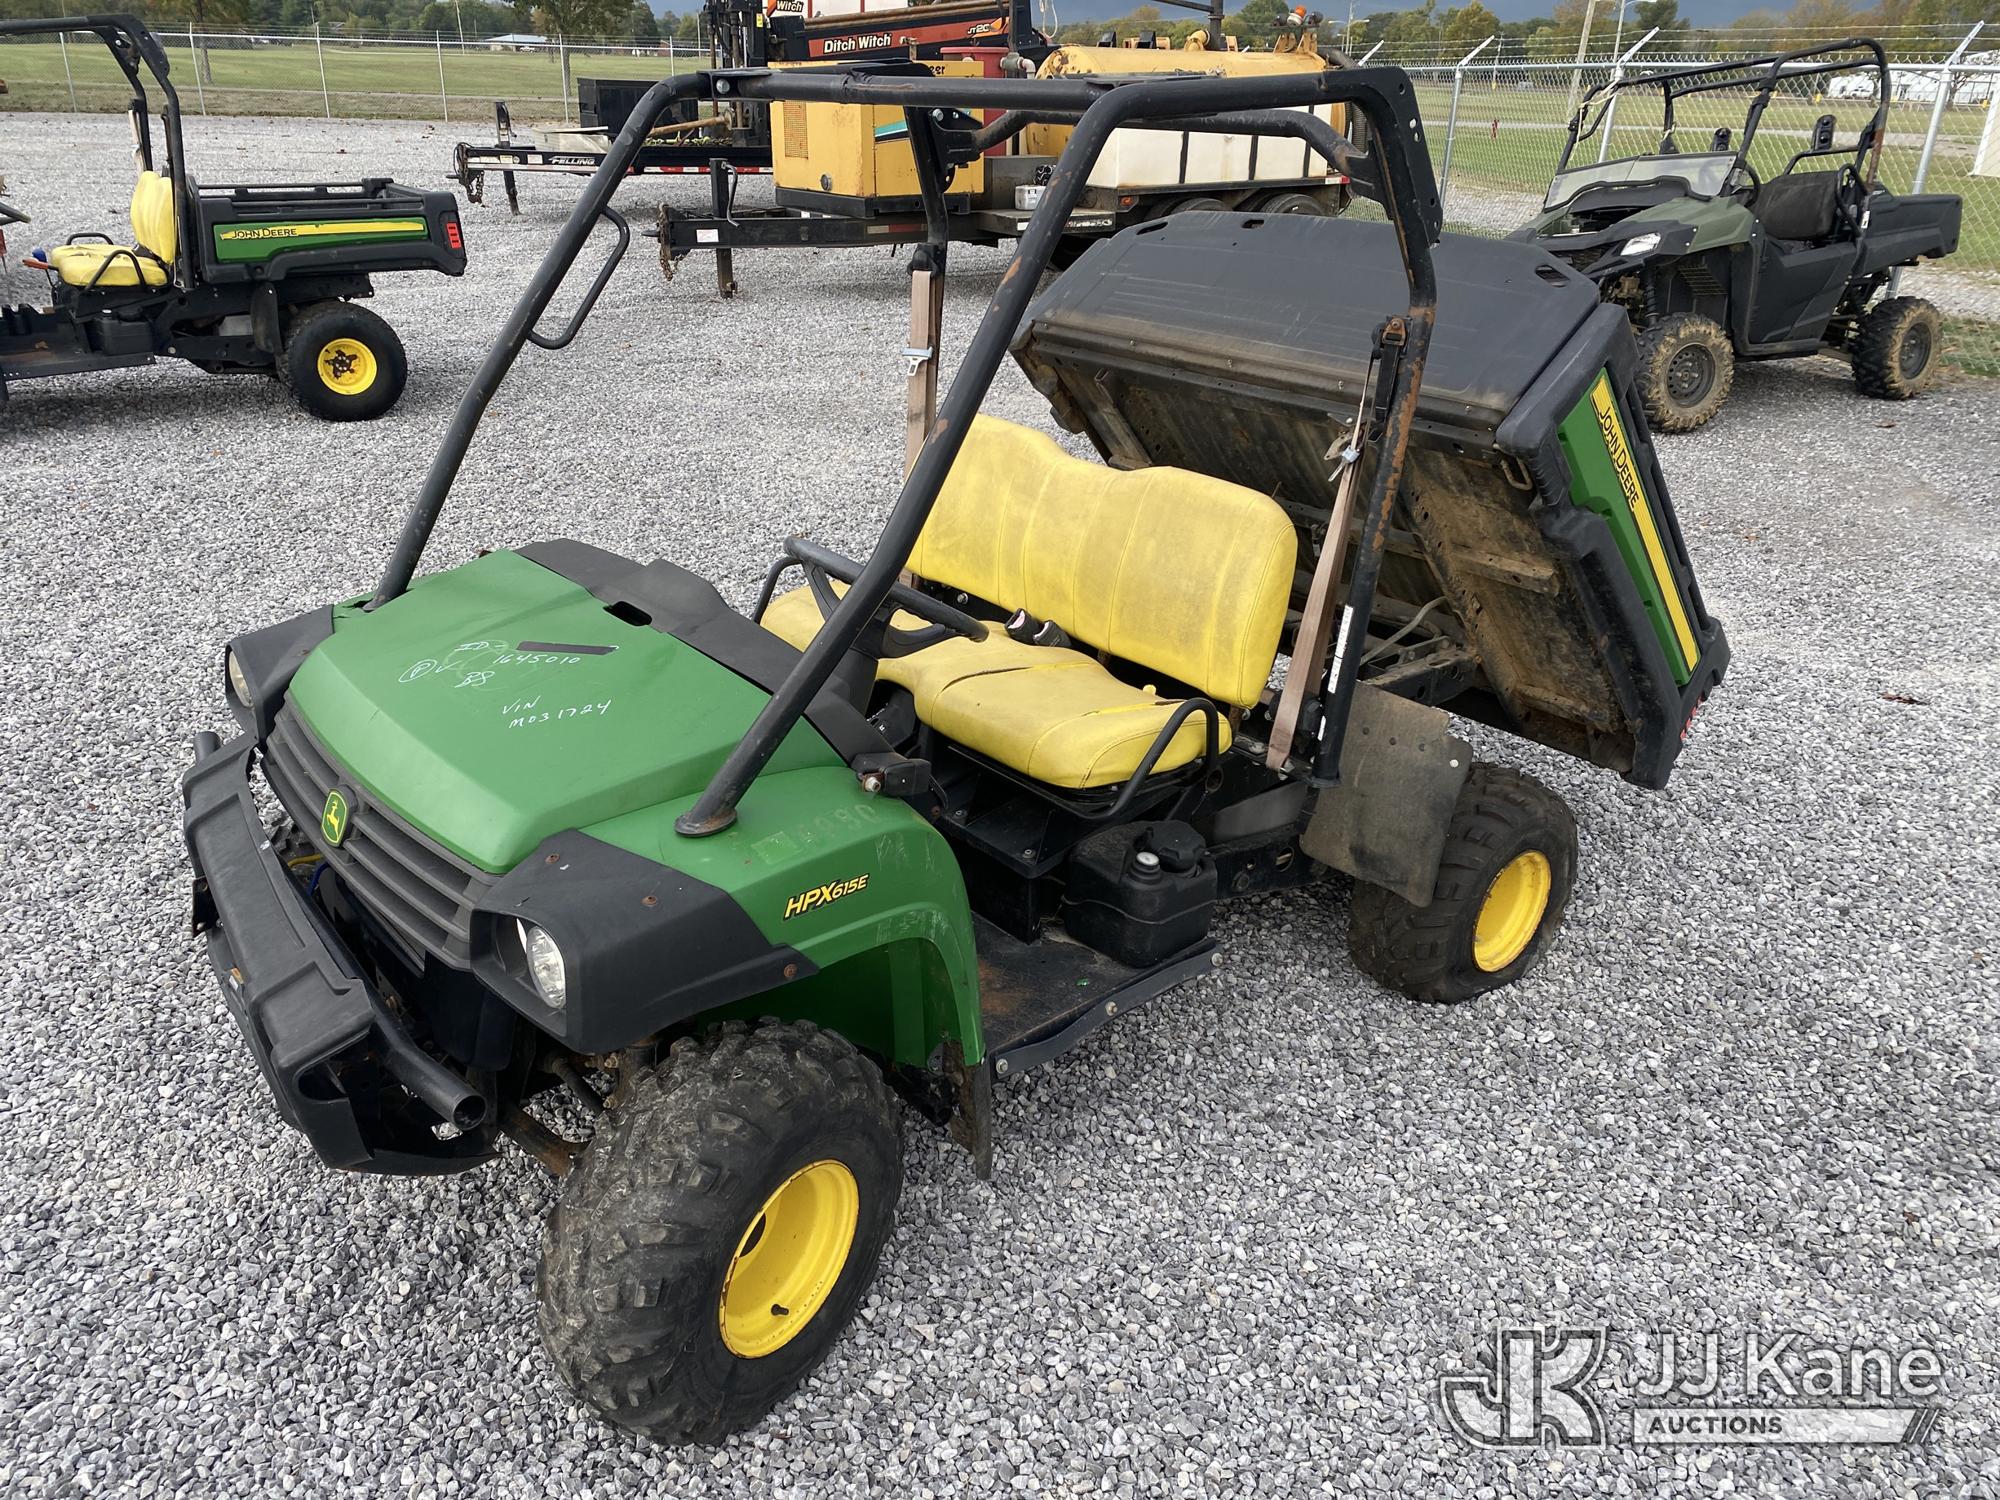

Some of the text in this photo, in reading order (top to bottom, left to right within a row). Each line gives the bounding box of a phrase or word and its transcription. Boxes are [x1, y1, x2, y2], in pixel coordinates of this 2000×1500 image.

[776, 0, 804, 12] Witch
[823, 34, 892, 53] Ditch Witch
[549, 156, 596, 166] FELLING
[232, 227, 297, 239] JOHN DEERE
[1599, 406, 1640, 509] JOHN DEERE
[503, 695, 541, 715] VIN
